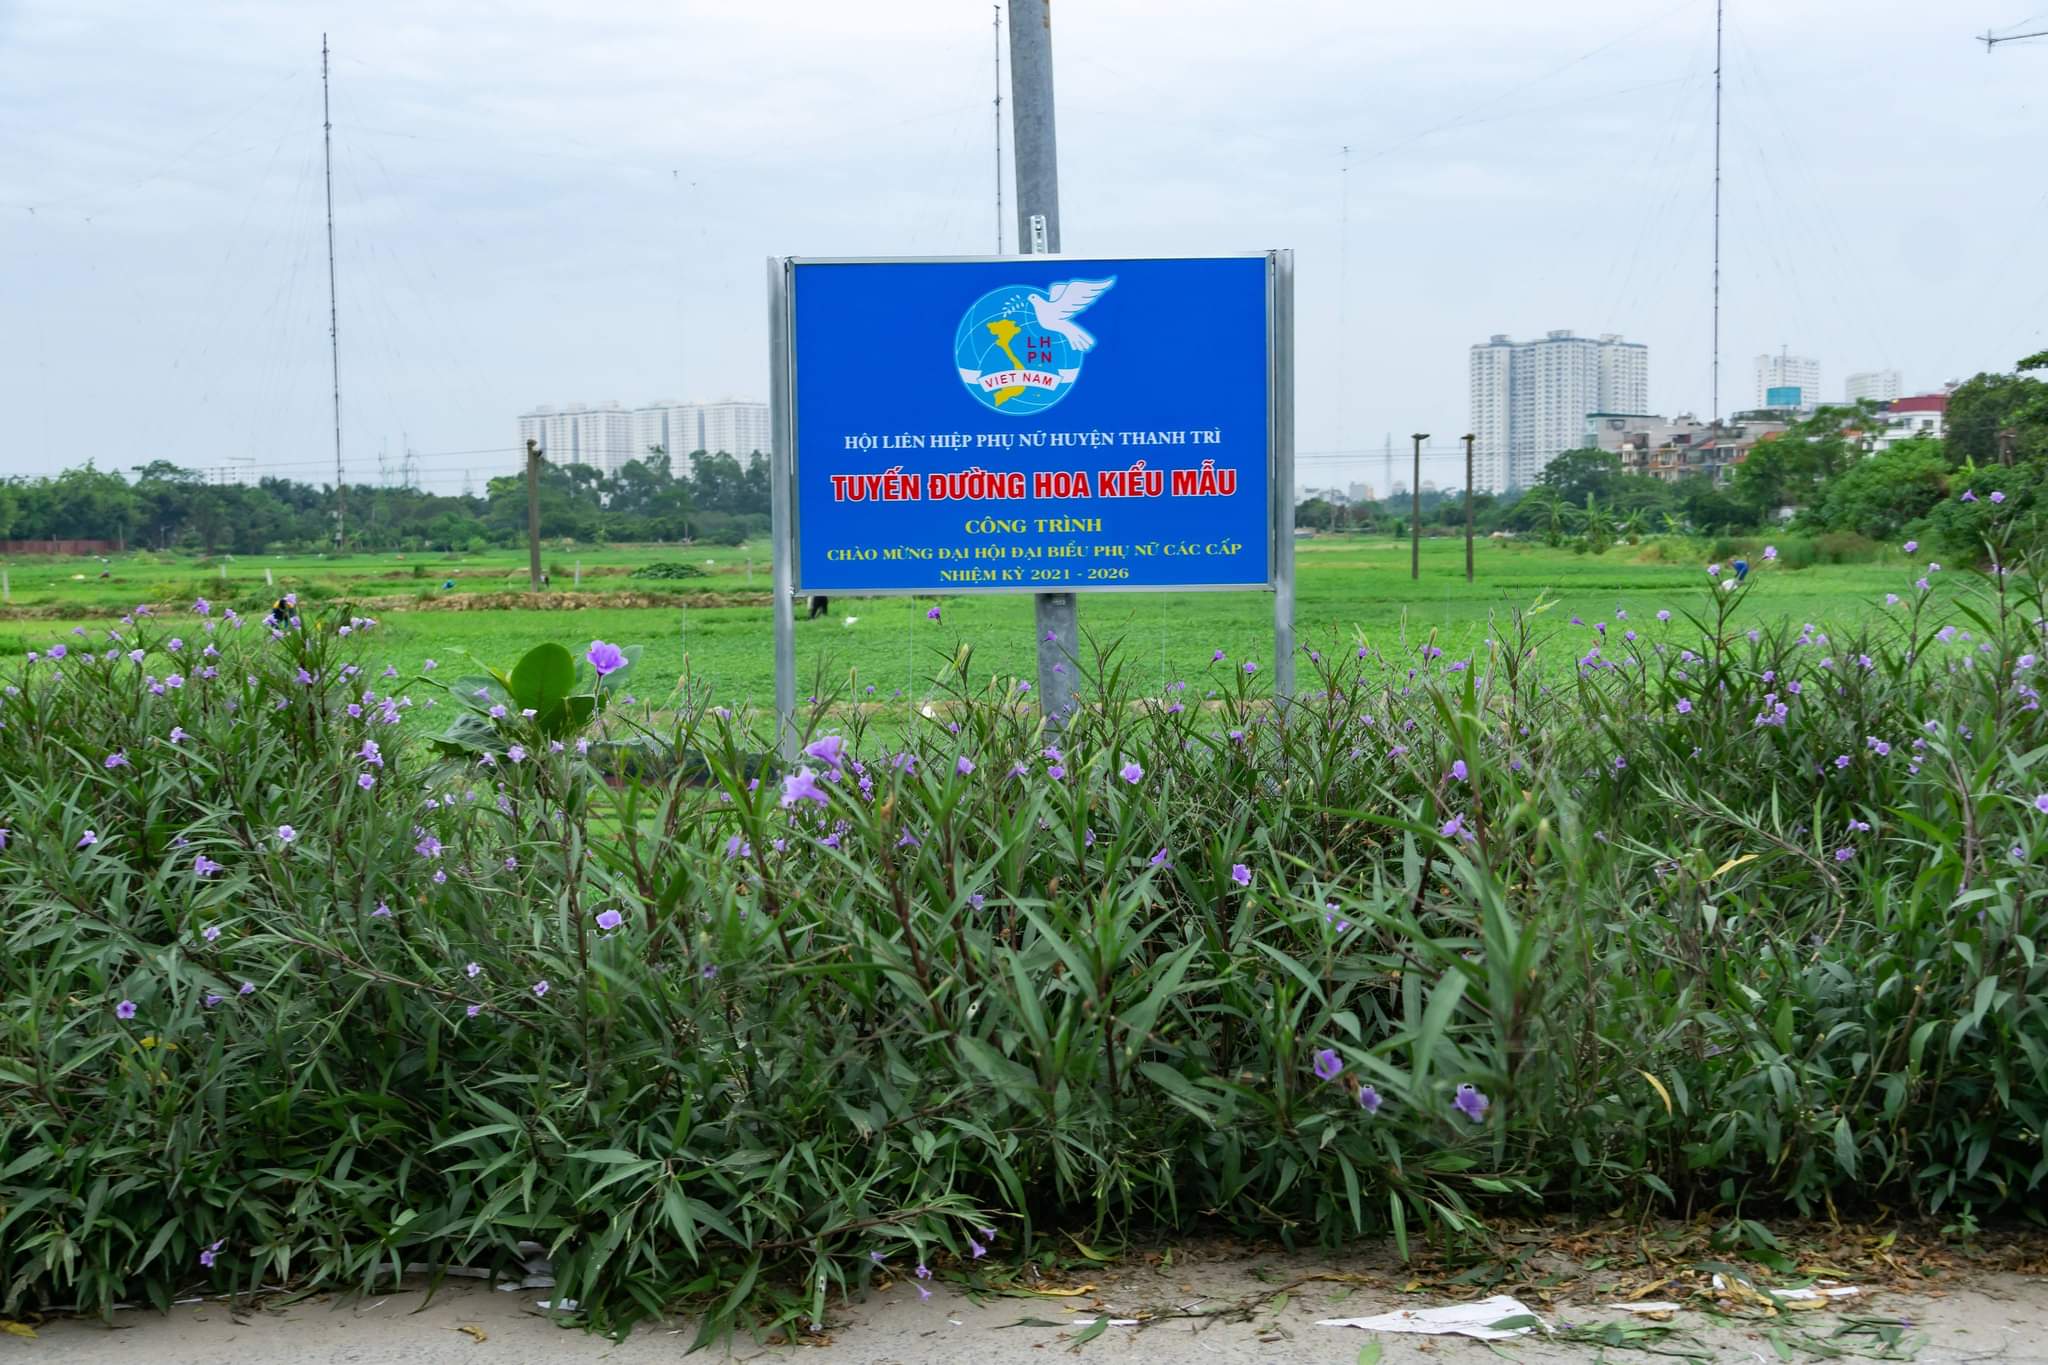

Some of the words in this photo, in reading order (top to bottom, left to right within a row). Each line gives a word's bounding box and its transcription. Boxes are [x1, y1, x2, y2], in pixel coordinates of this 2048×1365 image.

[984, 373, 1017, 388] VIET
[1023, 372, 1053, 386] NAM
[844, 432, 878, 452] HỘI
[882, 431, 925, 449] LIÊN
[930, 431, 973, 451] HIỆP
[976, 434, 1014, 450] PHỤ
[1019, 430, 1047, 447] NỮ
[1050, 429, 1115, 449] HUYỆN
[1119, 431, 1185, 445] THANH
[1190, 427, 1221, 444] TRÌ
[830, 465, 921, 502] TUYẾN
[928, 466, 1026, 501] ĐƯỜNG
[1033, 470, 1092, 499] HOA
[1098, 459, 1164, 498] KIỂU
[1171, 458, 1237, 497] MẪU
[965, 515, 1027, 535] CÔNG
[1033, 514, 1102, 533] TRÌNH
[826, 545, 878, 561] CHÀO
[882, 545, 933, 560] MỪNG
[938, 547, 969, 562] ĐẠI
[974, 544, 1006, 561] HỘI
[1011, 546, 1042, 561] ĐẠI
[1048, 540, 1088, 558] BIỂU
[1094, 544, 1130, 559] PHỤ
[1135, 541, 1160, 556] NỮ
[1163, 540, 1200, 556] CÁC
[1205, 538, 1242, 555] CẤP
[940, 565, 997, 584] NHIỆM
[1002, 565, 1025, 582] KỲ
[1031, 568, 1071, 580] 2021
[1087, 568, 1130, 580] 2026
